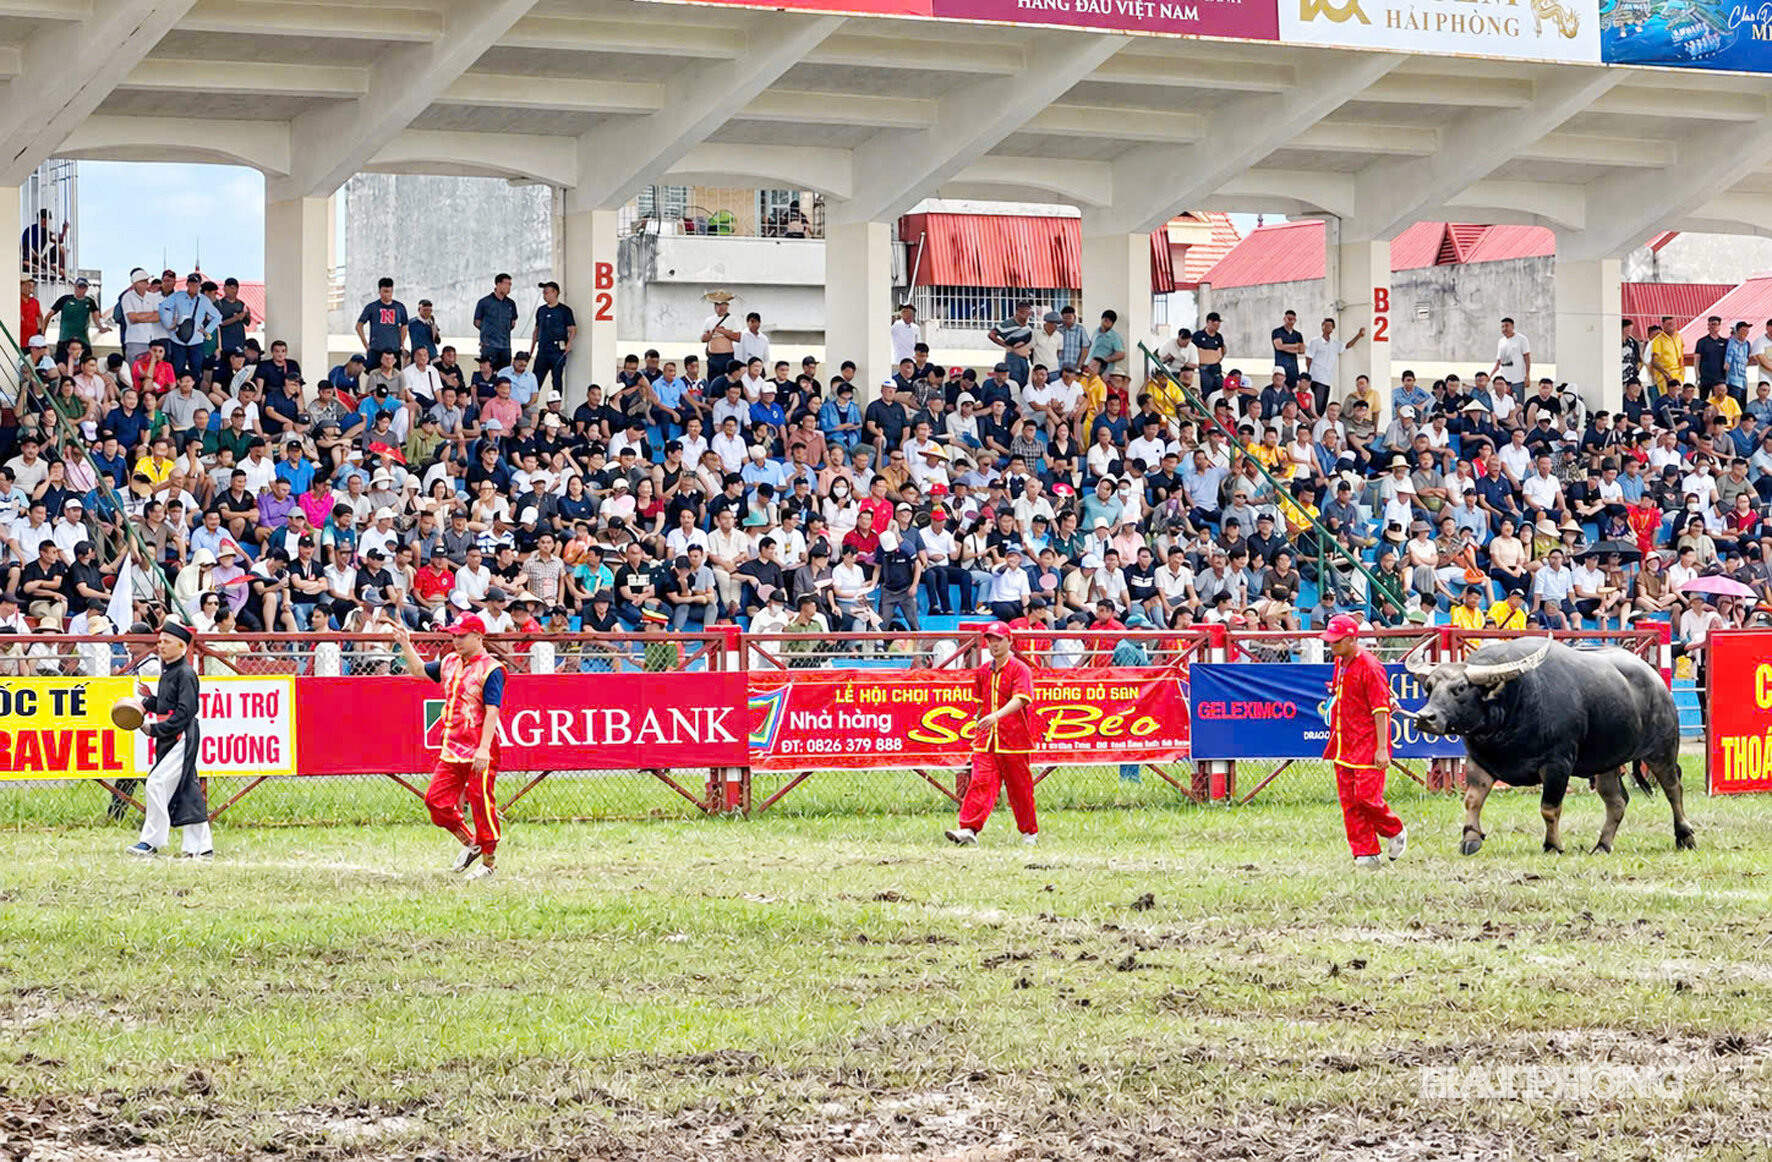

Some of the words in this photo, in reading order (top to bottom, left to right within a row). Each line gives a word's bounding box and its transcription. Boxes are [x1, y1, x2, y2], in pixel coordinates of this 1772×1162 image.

[1160, 3, 1200, 21] NAM
[1386, 4, 1429, 31] HẢI
[1435, 9, 1520, 37] PHÒNG
[48, 682, 90, 717] TẾ
[199, 688, 232, 719] TÀI
[239, 688, 280, 724] TRỢ
[1197, 701, 1298, 720] GELEXIMCO
[789, 709, 833, 730] Nhà
[839, 708, 892, 733] hàng
[1036, 705, 1161, 742] Béo
[201, 733, 280, 765] CƯƠNG
[781, 740, 804, 754] ĐT:
[806, 738, 843, 753] 0826
[846, 738, 872, 752] 379
[875, 737, 903, 752] 888
